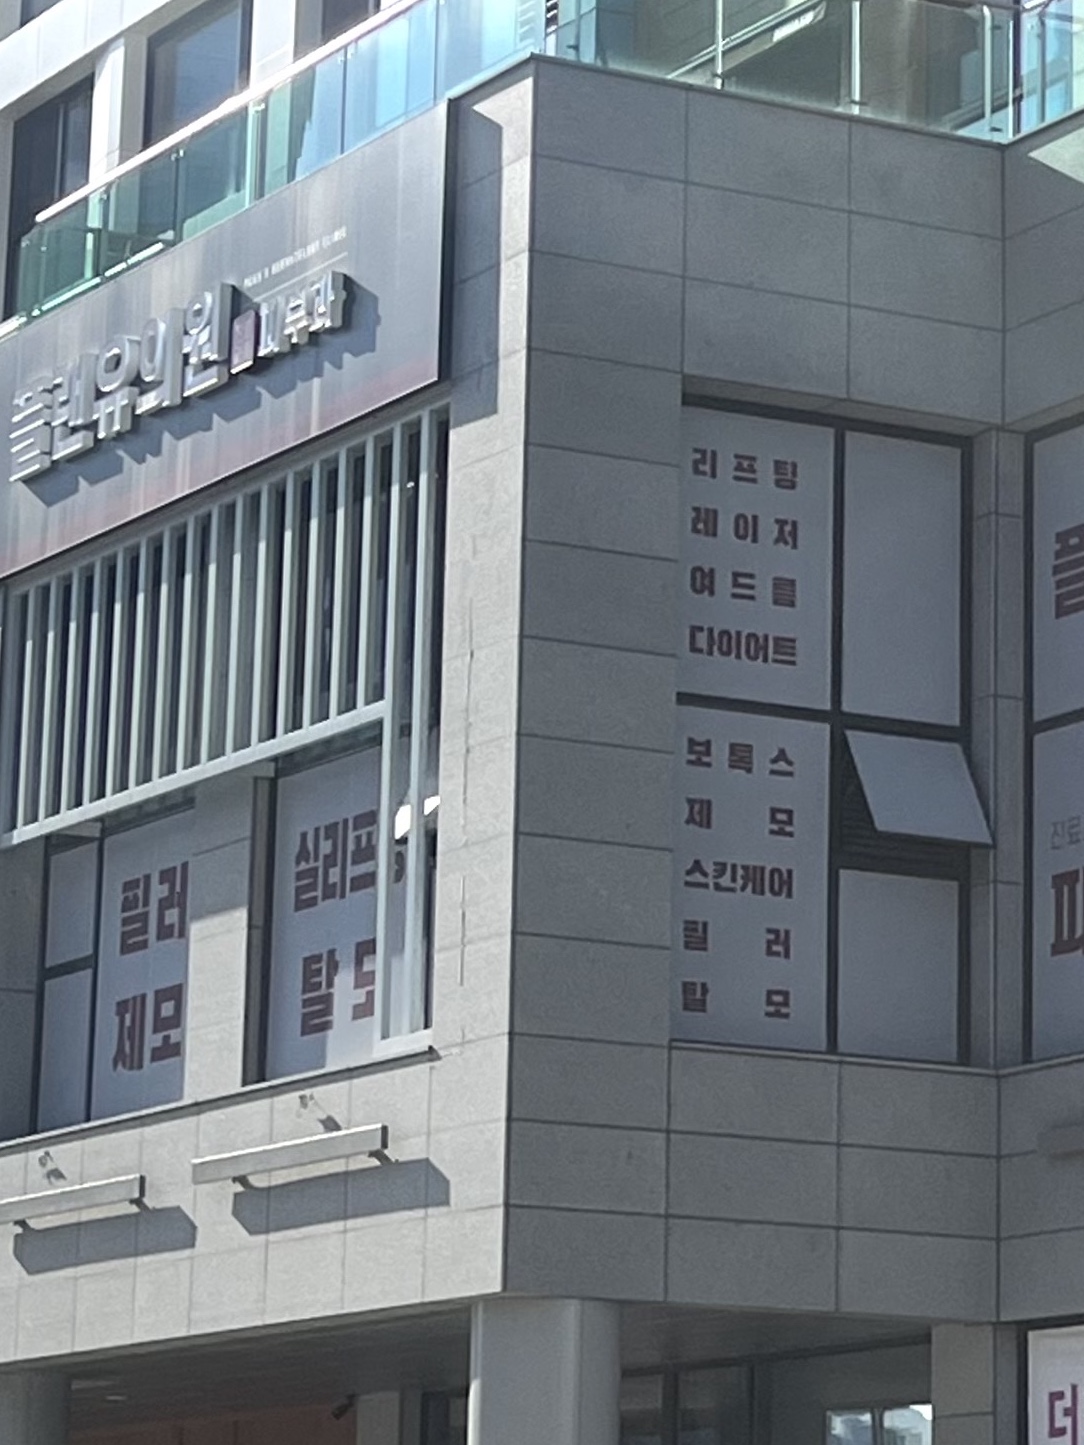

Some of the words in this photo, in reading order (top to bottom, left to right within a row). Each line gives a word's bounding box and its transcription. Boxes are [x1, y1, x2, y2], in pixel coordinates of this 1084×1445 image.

[691, 447, 798, 490] 리프팅
[690, 505, 799, 550] 레이저
[689, 564, 797, 608] 여드름
[688, 624, 797, 667] 다이어트
[685, 736, 795, 778] 보톡스
[294, 808, 405, 913] 실리프
[683, 858, 794, 899] 스킨케어
[119, 860, 190, 957] 필러
[112, 982, 184, 1072] 제모
